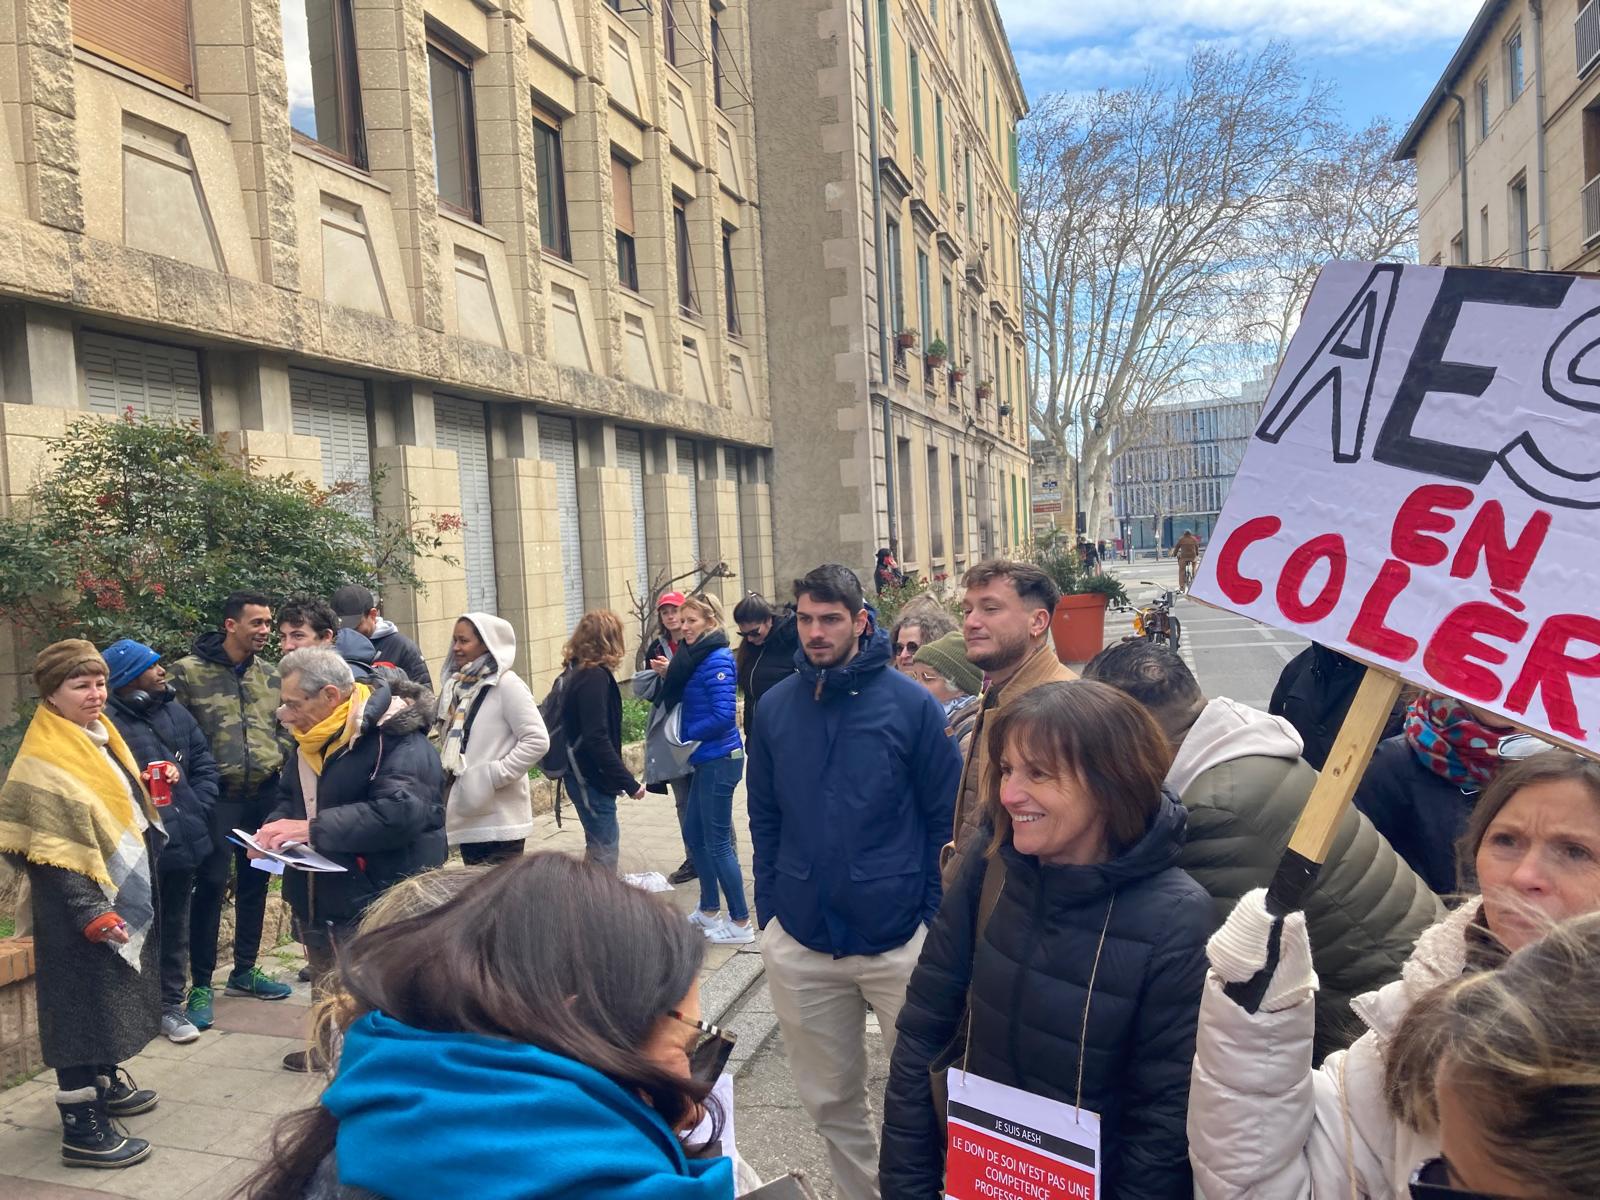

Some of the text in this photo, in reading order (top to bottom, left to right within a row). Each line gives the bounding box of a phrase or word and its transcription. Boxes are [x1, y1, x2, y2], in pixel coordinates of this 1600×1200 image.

[1256, 263, 1600, 509] AES
[1391, 484, 1553, 593] EN
[1216, 516, 1600, 741] COLÈR
[995, 1120, 1042, 1144] JE SUIS AESH
[953, 1136, 1090, 1200] LE DON DE SOI N'EST PAS UNE
[975, 1178, 1023, 1200] PROFESS
[985, 1166, 1051, 1200] COMPETENCE
